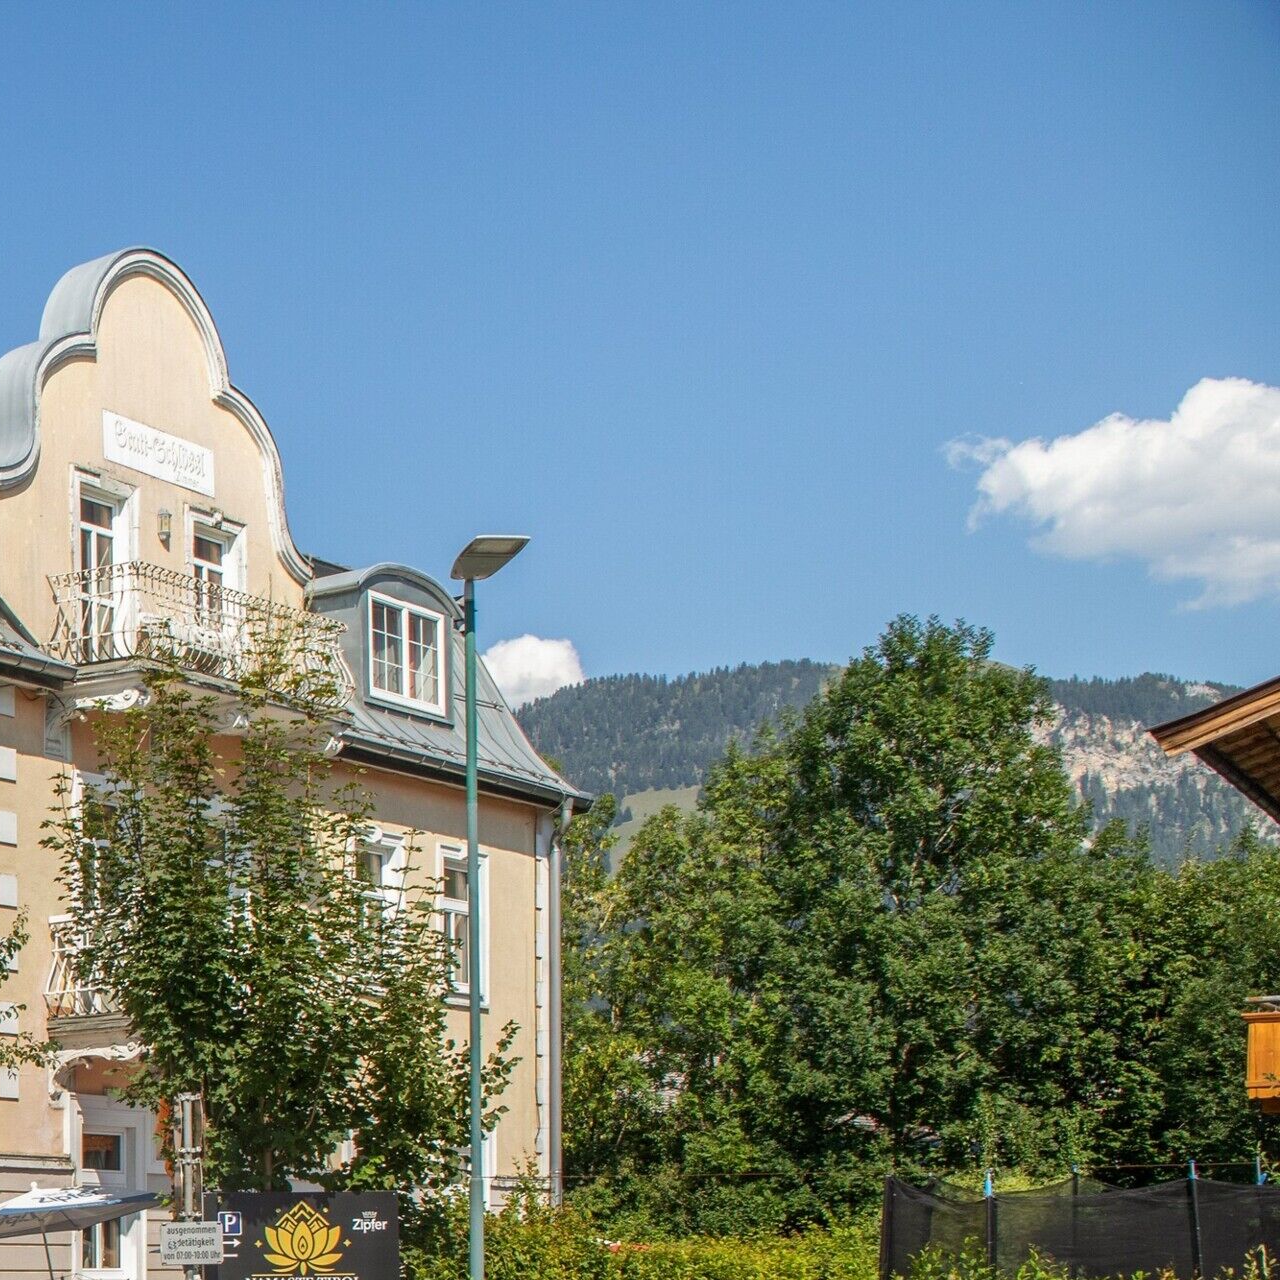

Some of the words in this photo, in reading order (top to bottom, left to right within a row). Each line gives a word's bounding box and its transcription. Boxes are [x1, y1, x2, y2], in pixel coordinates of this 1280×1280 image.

[224, 1214, 237, 1233] P
[352, 1218, 388, 1234] Zipfer
[166, 1227, 217, 1236] ausgenommen
[210, 1250, 220, 1259] Uhr
